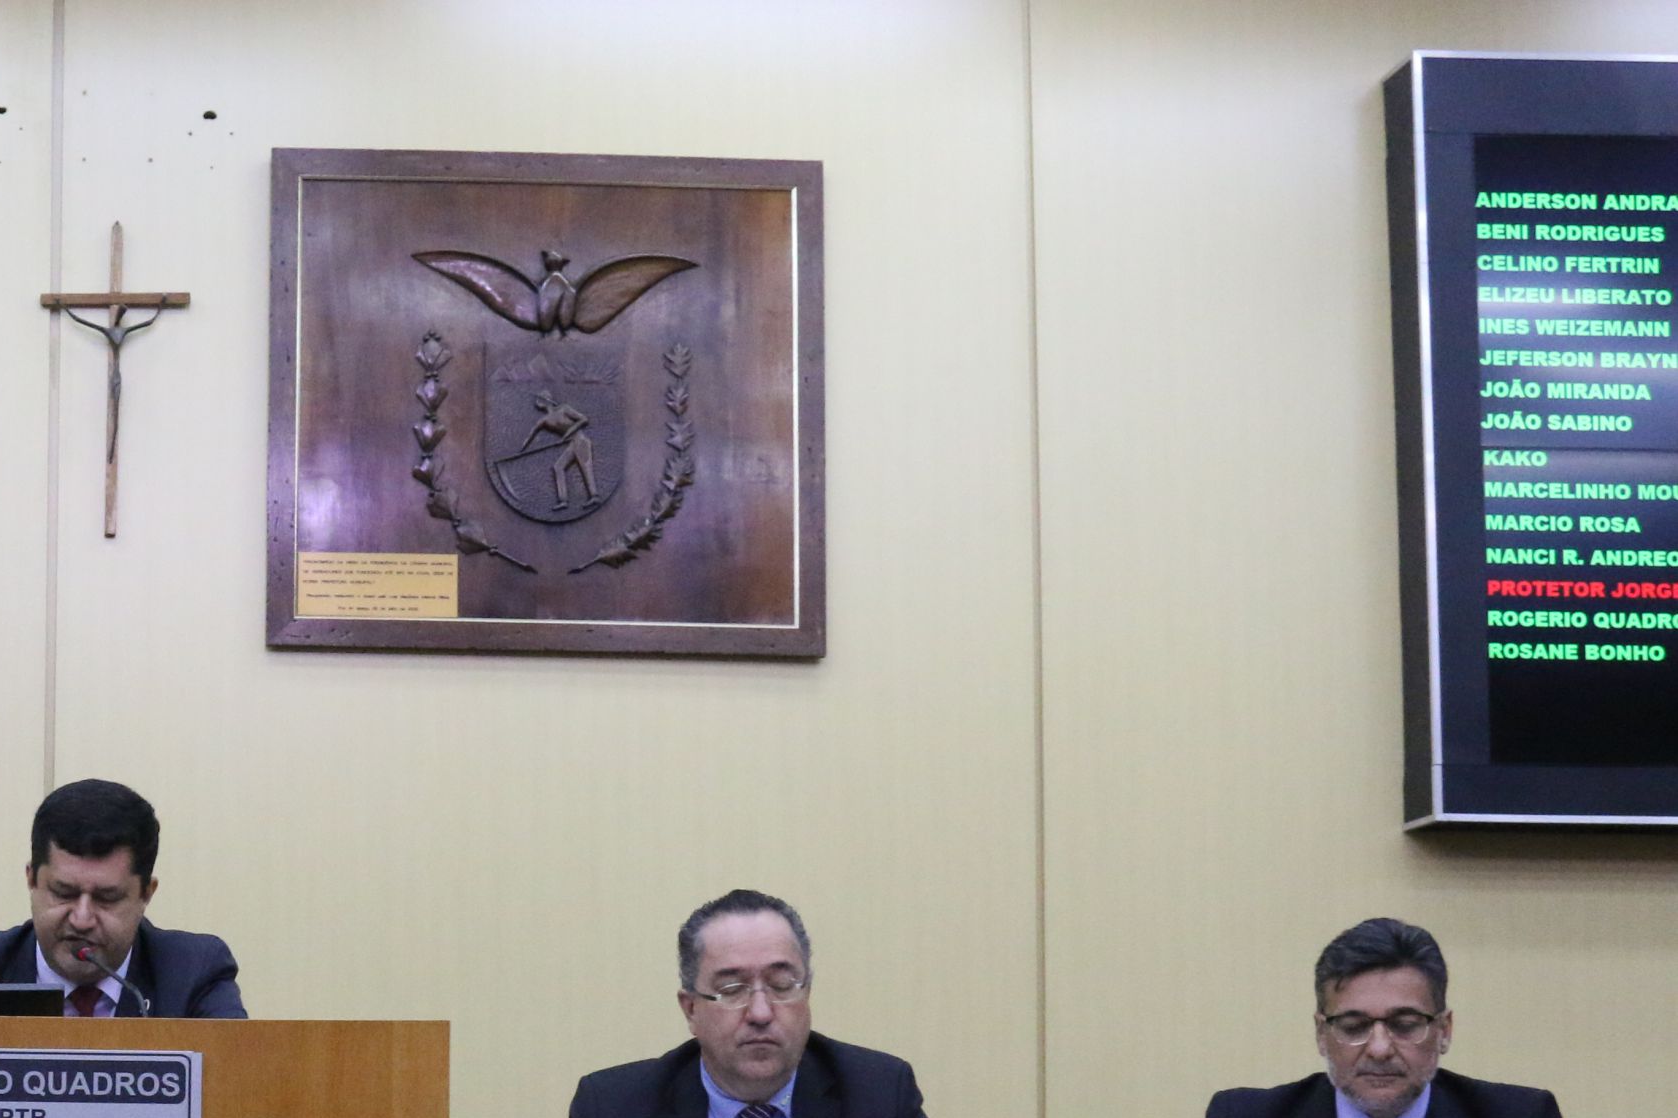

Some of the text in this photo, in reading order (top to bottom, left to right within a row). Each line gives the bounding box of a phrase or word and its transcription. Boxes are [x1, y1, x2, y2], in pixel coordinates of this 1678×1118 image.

[1475, 192, 1678, 211] ANDERSON ANDRA
[1476, 223, 1665, 242] BENI RODRIGUES
[1477, 255, 1659, 274] CELINO FERTRIN
[1478, 286, 1672, 306] ELIZEU LIBERATO
[1479, 318, 1670, 337] INES WEIZEMANN
[1479, 350, 1678, 369] JEFERSON BRAYN
[1480, 378, 1651, 400] JOÃO MIRANDA
[1480, 410, 1632, 432] JOÃO SABINO
[1483, 450, 1548, 467] KAKO
[1484, 482, 1632, 500] MARCELINHO
[1485, 515, 1641, 533] MARCIO ROSA
[1486, 548, 1555, 565] NANCI
[1562, 549, 1584, 566] R.
[1487, 580, 1605, 598] PROTETOR
[1488, 611, 1588, 628] ROGERIO
[1489, 643, 1665, 662] ROSANE BONHO
[23, 1070, 180, 1097] QUADROS
